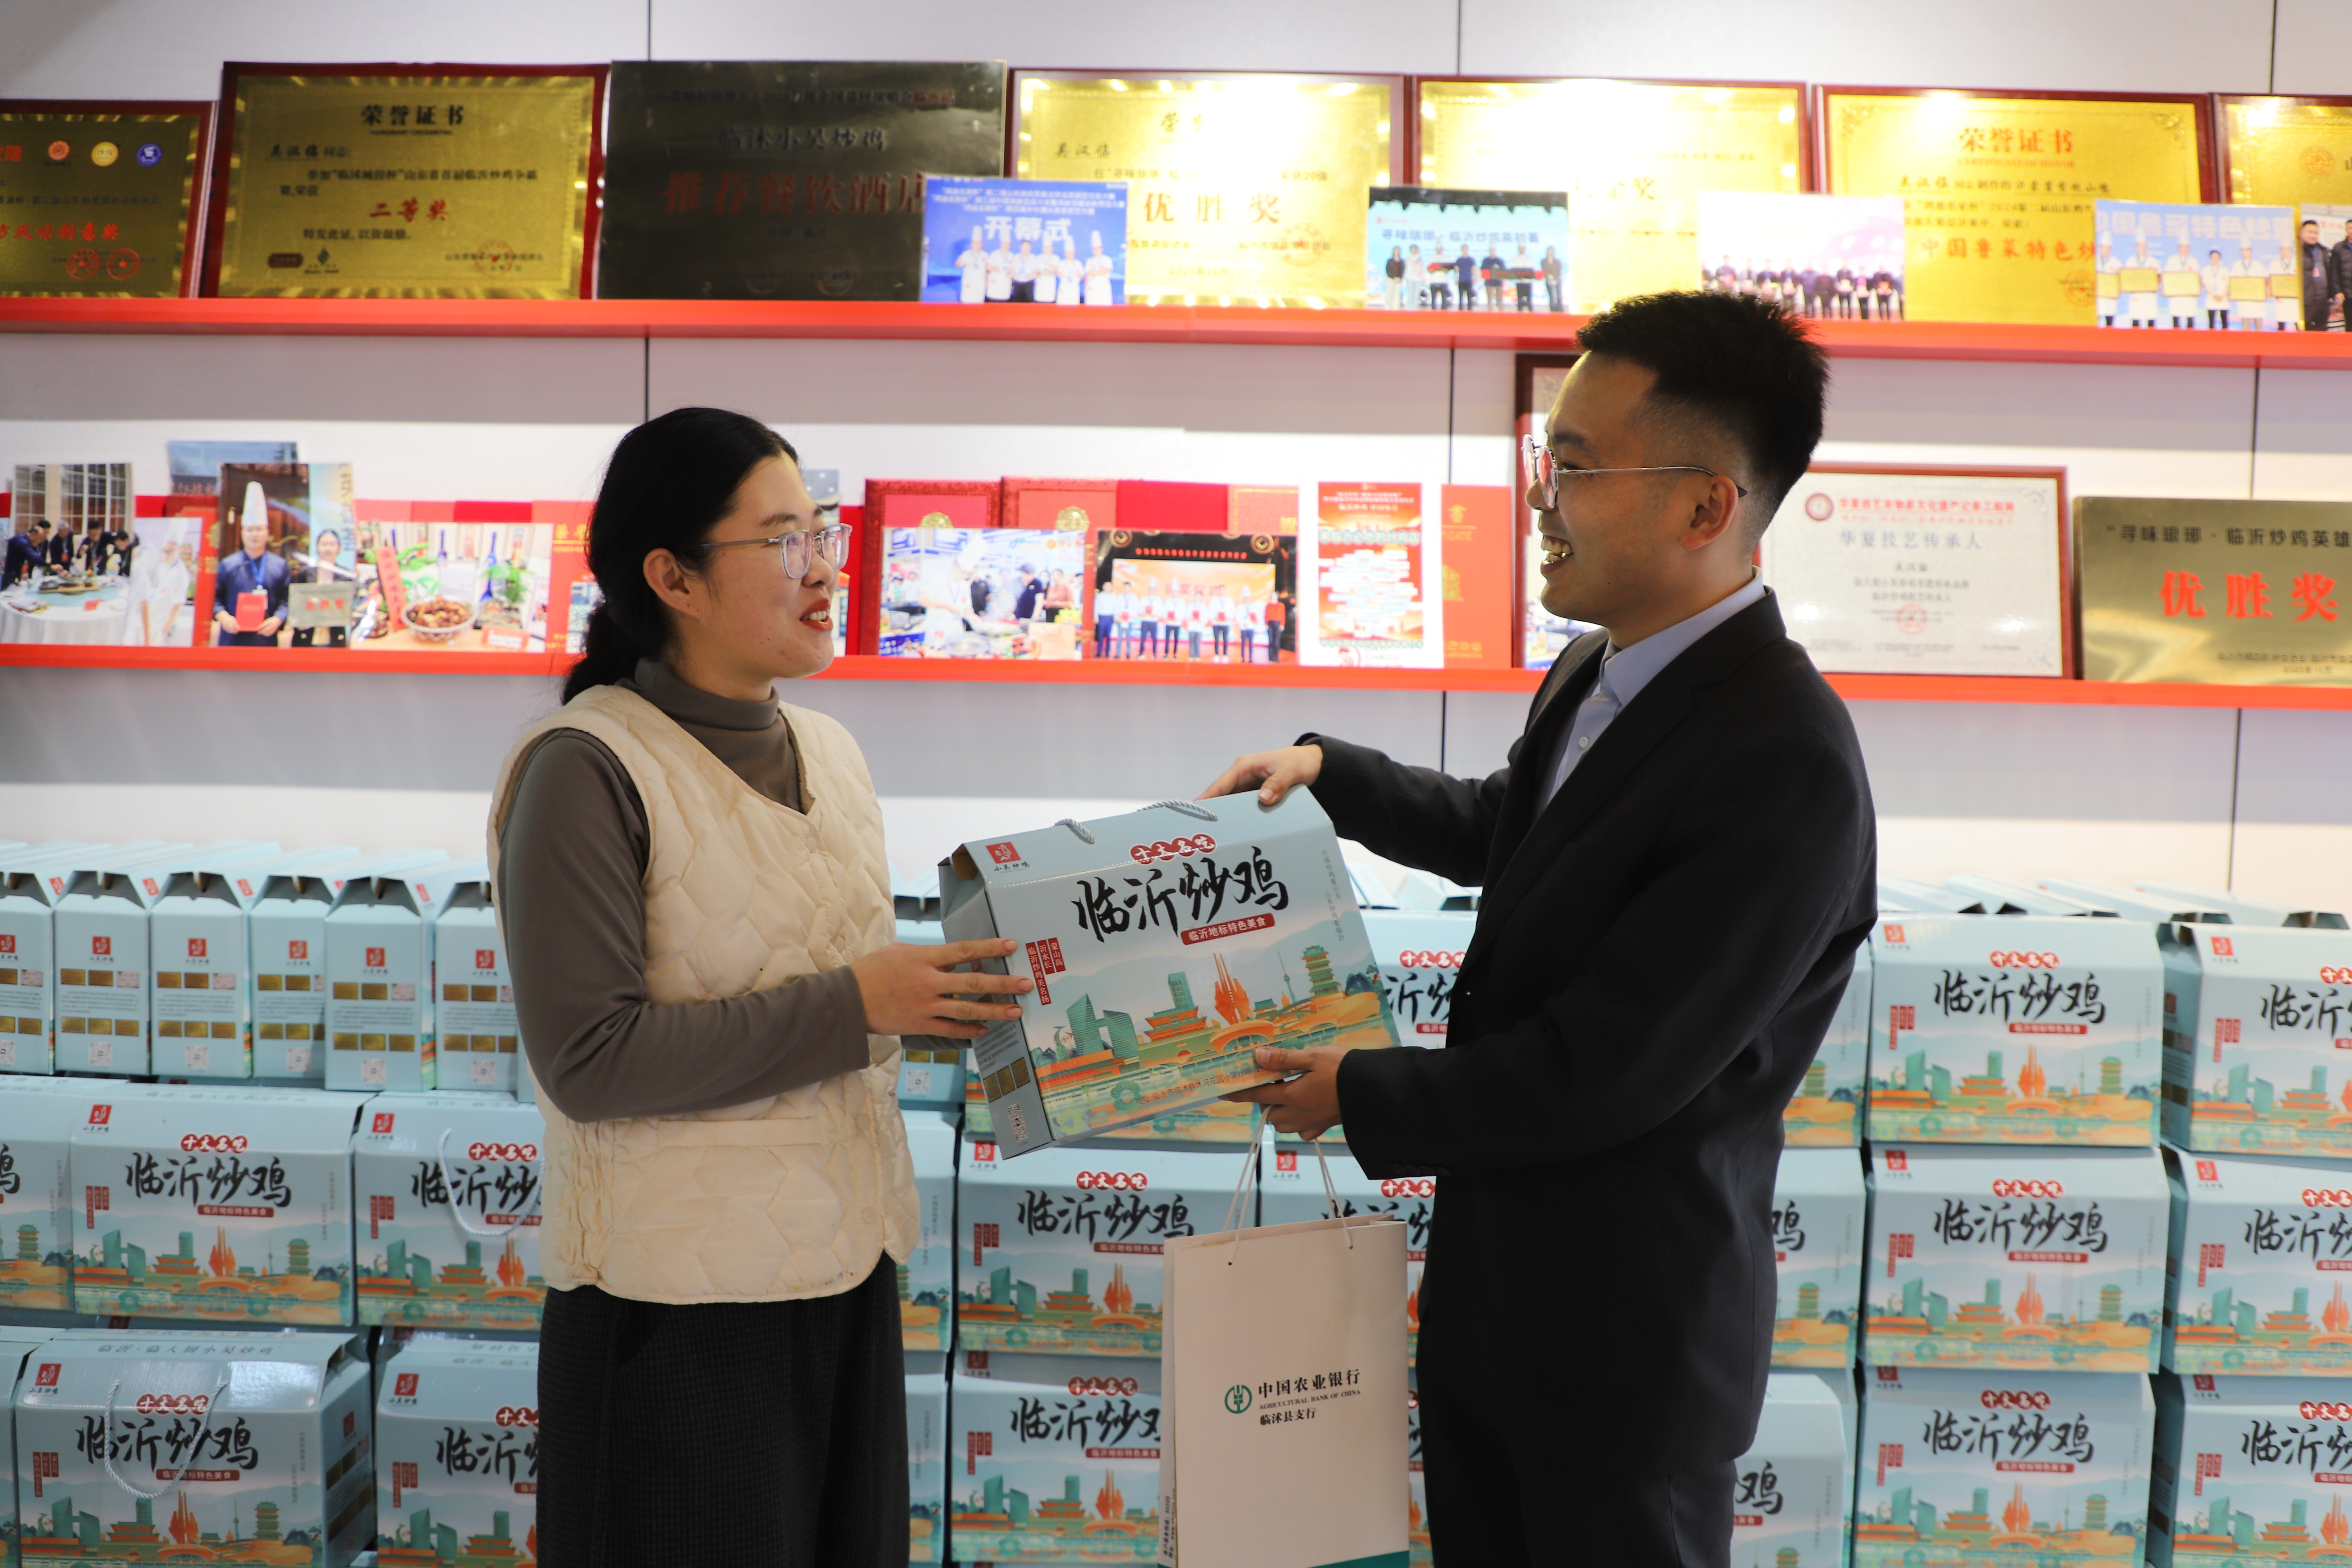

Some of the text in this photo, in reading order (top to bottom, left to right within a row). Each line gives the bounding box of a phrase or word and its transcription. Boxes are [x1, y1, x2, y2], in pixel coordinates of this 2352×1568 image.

[361, 104, 464, 125] 荣誉证书
[1960, 126, 2074, 155] 荣誉证书
[369, 198, 450, 223] 二等奖
[1144, 192, 1282, 224] 优胜奖
[983, 215, 1073, 241] 开幕式
[1841, 529, 1982, 550] 华夏技艺传承人
[2158, 570, 2340, 622] 优胜奖
[1135, 835, 1215, 863] 十大名吃
[994, 861, 1030, 871] 小吴炒鸡
[1071, 846, 1289, 943] 临沂炒鸡
[1188, 916, 1266, 942] 临沂地标特色美食
[1039, 944, 1052, 969] 沂水长
[1050, 942, 1064, 966] 蒙山高
[1994, 952, 2060, 968] 十大名吃
[1027, 946, 1050, 1004] 临沂炒鸡美名扬
[1934, 969, 2107, 1024] 临沂炒鸡
[2261, 983, 2352, 1041] 临沂
[185, 1138, 246, 1153] 十大名吃
[471, 1145, 537, 1161] 十大名吃
[124, 1152, 292, 1208] 临沂炒鸡
[411, 1160, 542, 1217] 临沂炒
[1079, 1173, 1147, 1190] 十大名吃
[1995, 1181, 2063, 1198] 十大名吃
[1017, 1189, 1195, 1244] 临沂炒鸡
[1934, 1198, 2108, 1253] 临沂炒鸡
[1071, 1380, 1136, 1394] 十大名吃
[1258, 1369, 1361, 1398] 中国农业银行
[140, 1396, 209, 1413] 十大名吃
[1259, 1398, 1309, 1410] AGRICULTURAL
[1311, 1393, 1329, 1402] BANK
[1341, 1389, 1361, 1397] CHINA
[1983, 1392, 2050, 1409] 十大名吃
[499, 1410, 538, 1425] 十大
[1260, 1407, 1317, 1426] 临沭县支行
[76, 1415, 259, 1472] 临沂炒鸡
[1923, 1409, 2095, 1463] 临沂炒鸡
[1735, 1459, 1784, 1515] 鸡
